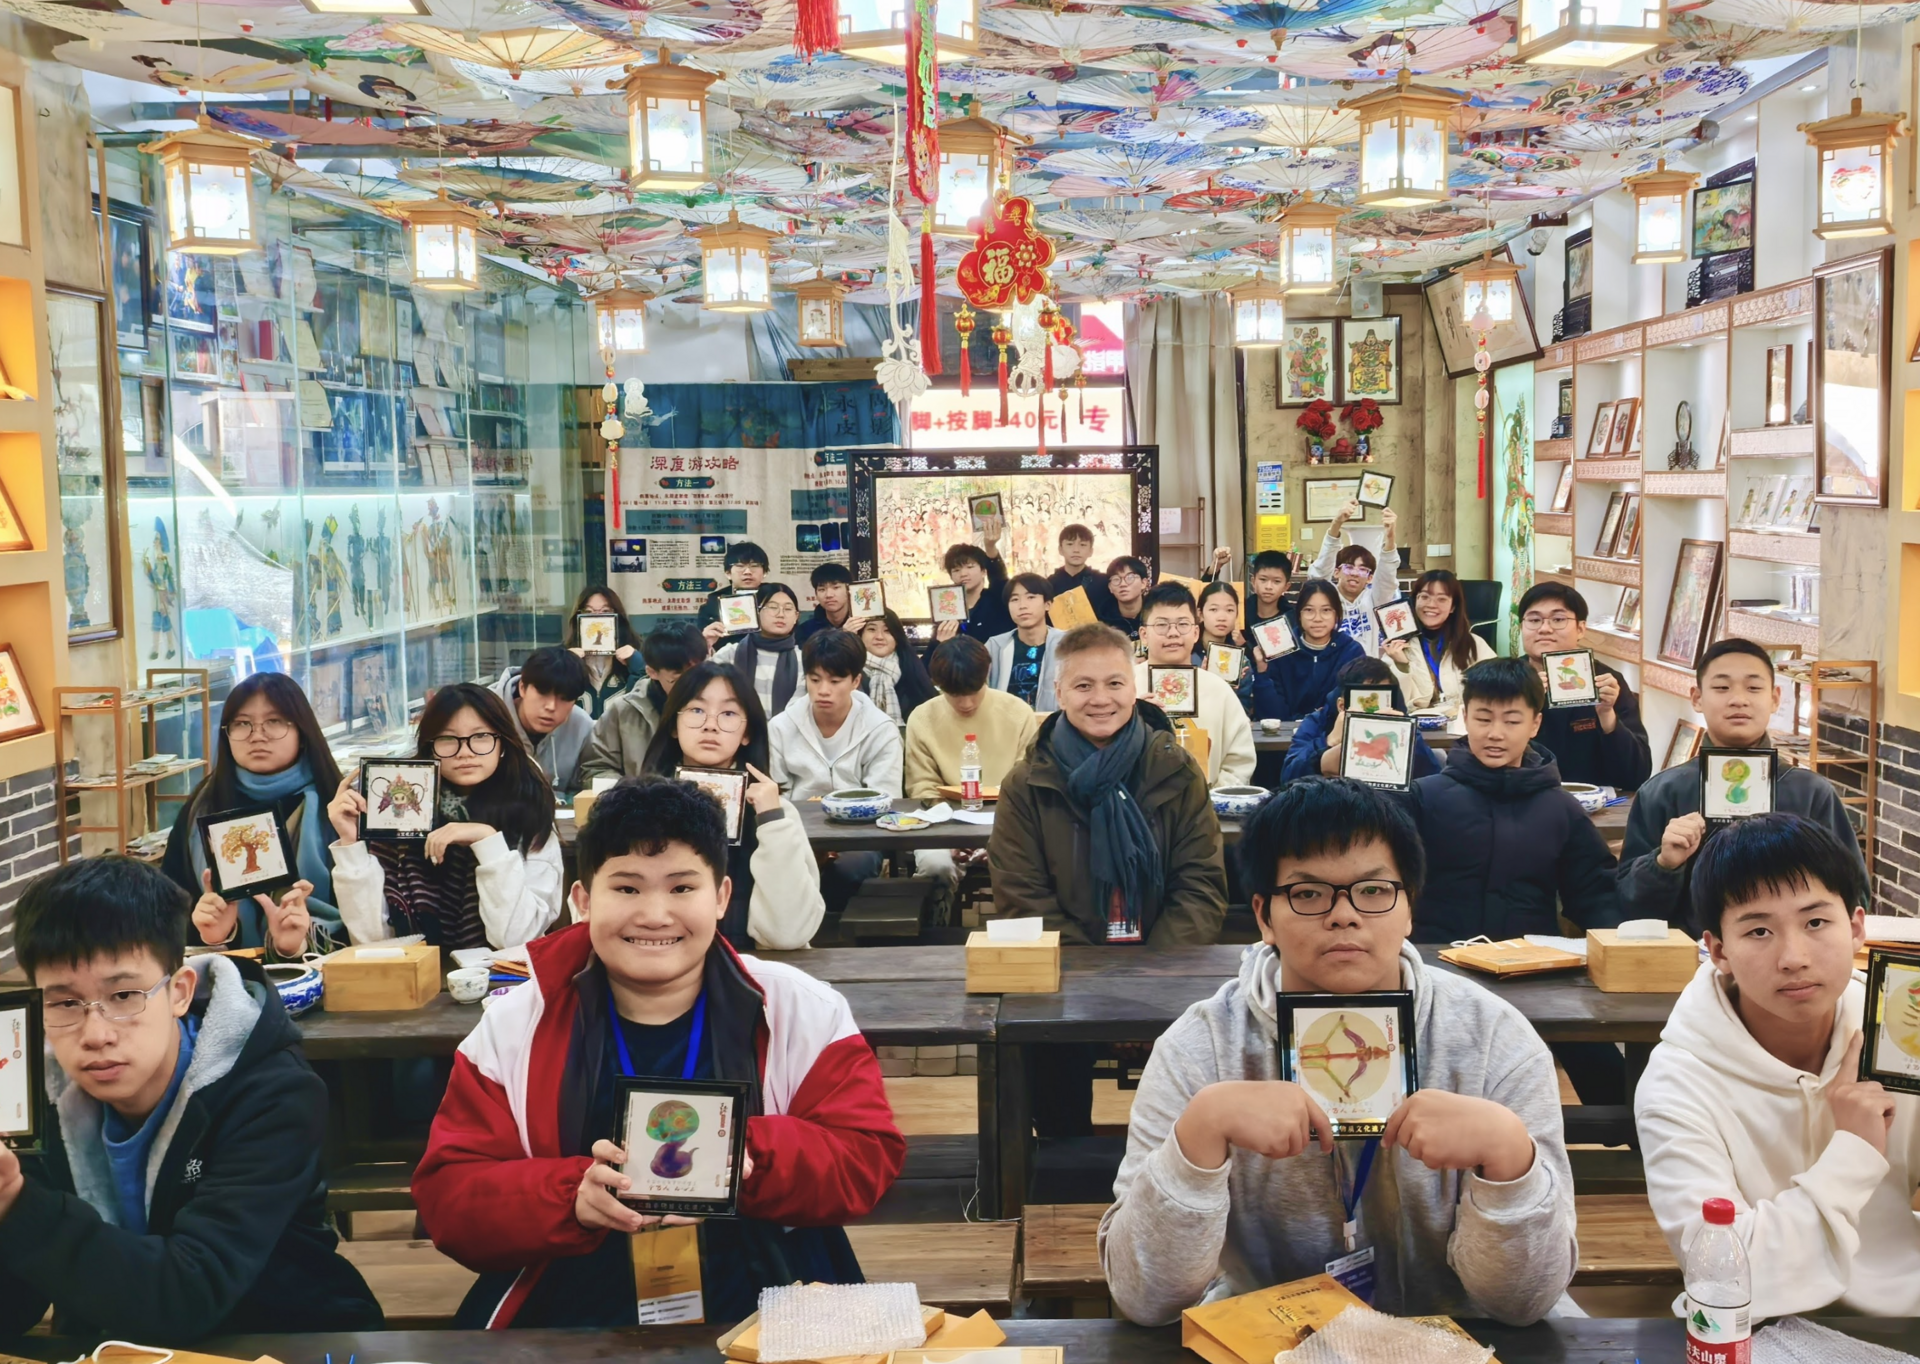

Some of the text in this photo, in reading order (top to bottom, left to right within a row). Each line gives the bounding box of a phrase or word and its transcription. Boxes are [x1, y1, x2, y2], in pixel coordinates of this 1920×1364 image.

[982, 247, 1014, 284] 福
[1085, 350, 1124, 373] 指甲
[1083, 405, 1110, 433] 专
[650, 455, 740, 472] 深度游攻略
[675, 479, 700, 488] 方法一
[677, 580, 702, 591] 方法三
